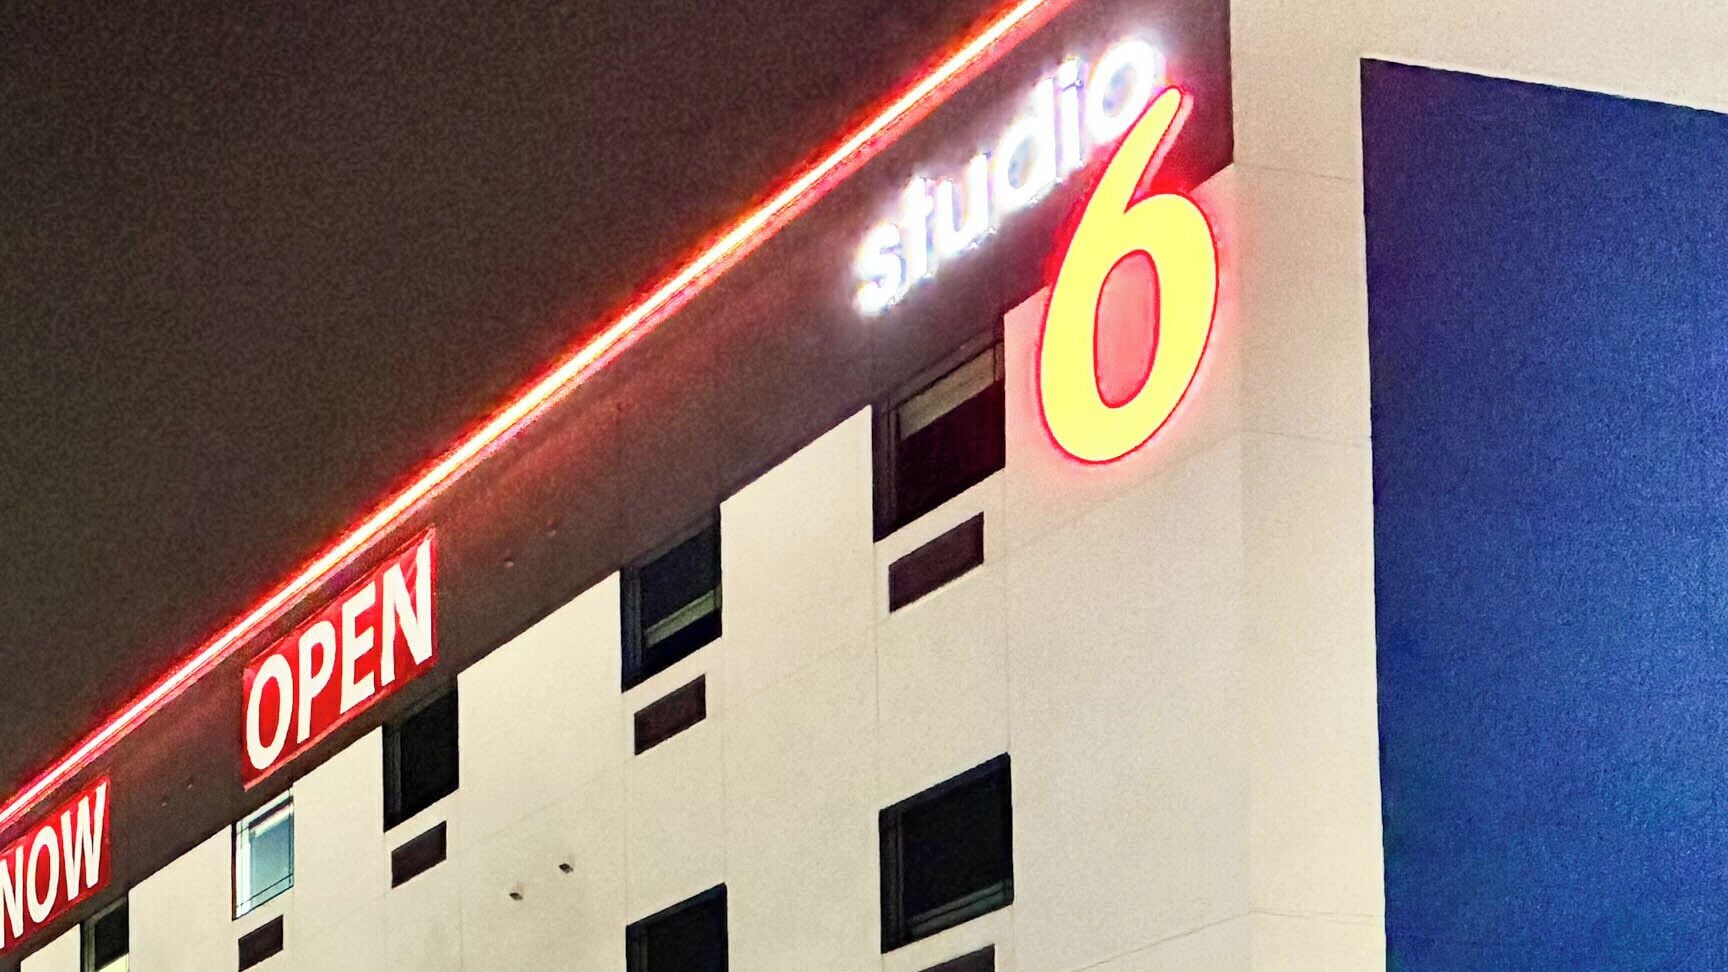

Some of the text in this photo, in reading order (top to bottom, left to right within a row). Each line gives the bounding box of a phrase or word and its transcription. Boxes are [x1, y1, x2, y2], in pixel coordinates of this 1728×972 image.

[856, 40, 1157, 315] studio
[1037, 85, 1219, 464] 6
[246, 539, 433, 769] OPEN
